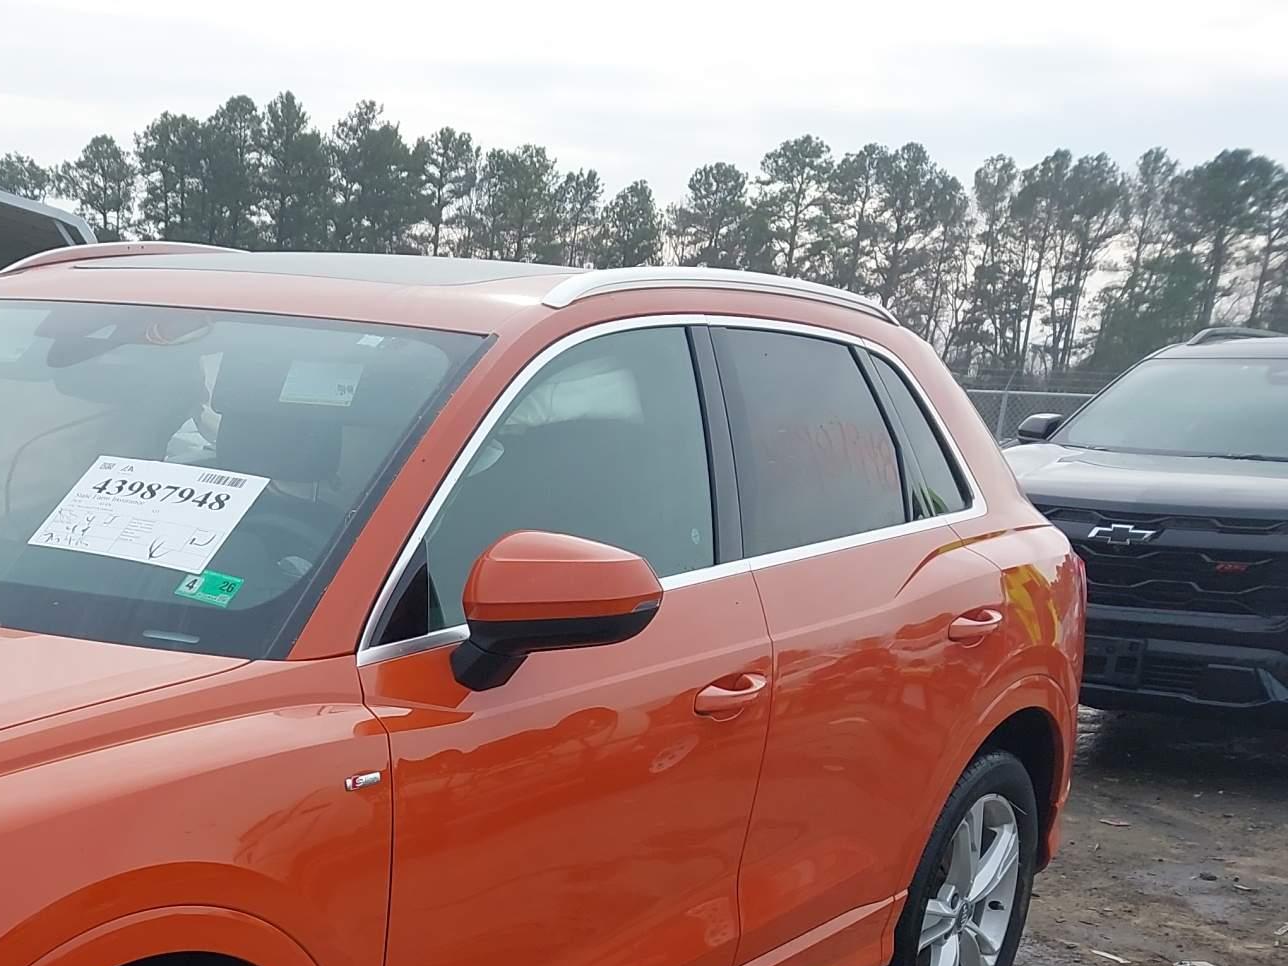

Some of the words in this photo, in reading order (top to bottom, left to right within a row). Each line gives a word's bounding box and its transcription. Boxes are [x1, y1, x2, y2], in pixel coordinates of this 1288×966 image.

[92, 478, 231, 511] 43987948
[185, 578, 198, 591] 4
[220, 581, 237, 593] 26
